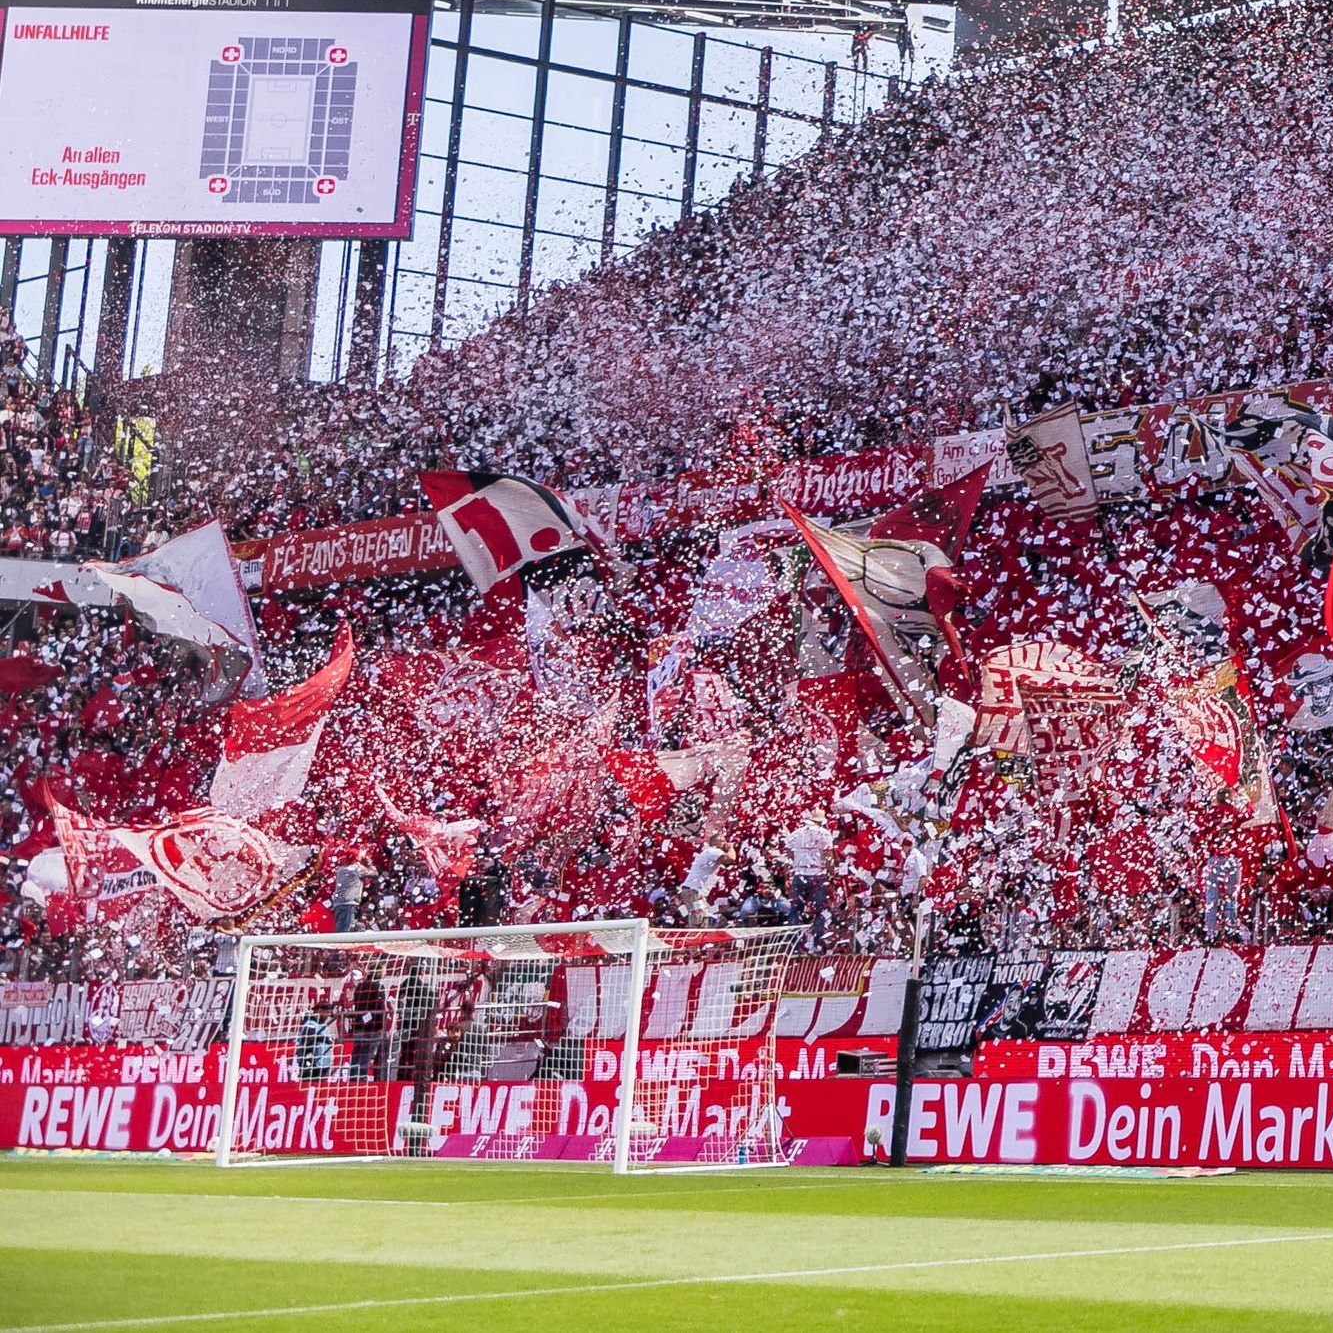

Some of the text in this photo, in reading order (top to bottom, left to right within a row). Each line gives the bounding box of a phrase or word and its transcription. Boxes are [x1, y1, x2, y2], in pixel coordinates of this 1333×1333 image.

[13, 24, 110, 41] UNFALLHILFE
[272, 46, 297, 54] NORD
[206, 115, 230, 123] WEST
[331, 117, 349, 125] OST
[62, 146, 120, 164] An allen
[31, 167, 146, 188] Eck-Ausgängen
[130, 222, 182, 235] TELEKOM
[272, 537, 348, 577] FC-FANS
[351, 526, 414, 566] GEGEN
[18, 1085, 136, 1147] REWE
[149, 1084, 223, 1149] Dein
[232, 1084, 339, 1151] Markt
[864, 1082, 1039, 1158] REWE
[1068, 1081, 1182, 1161] Dein
